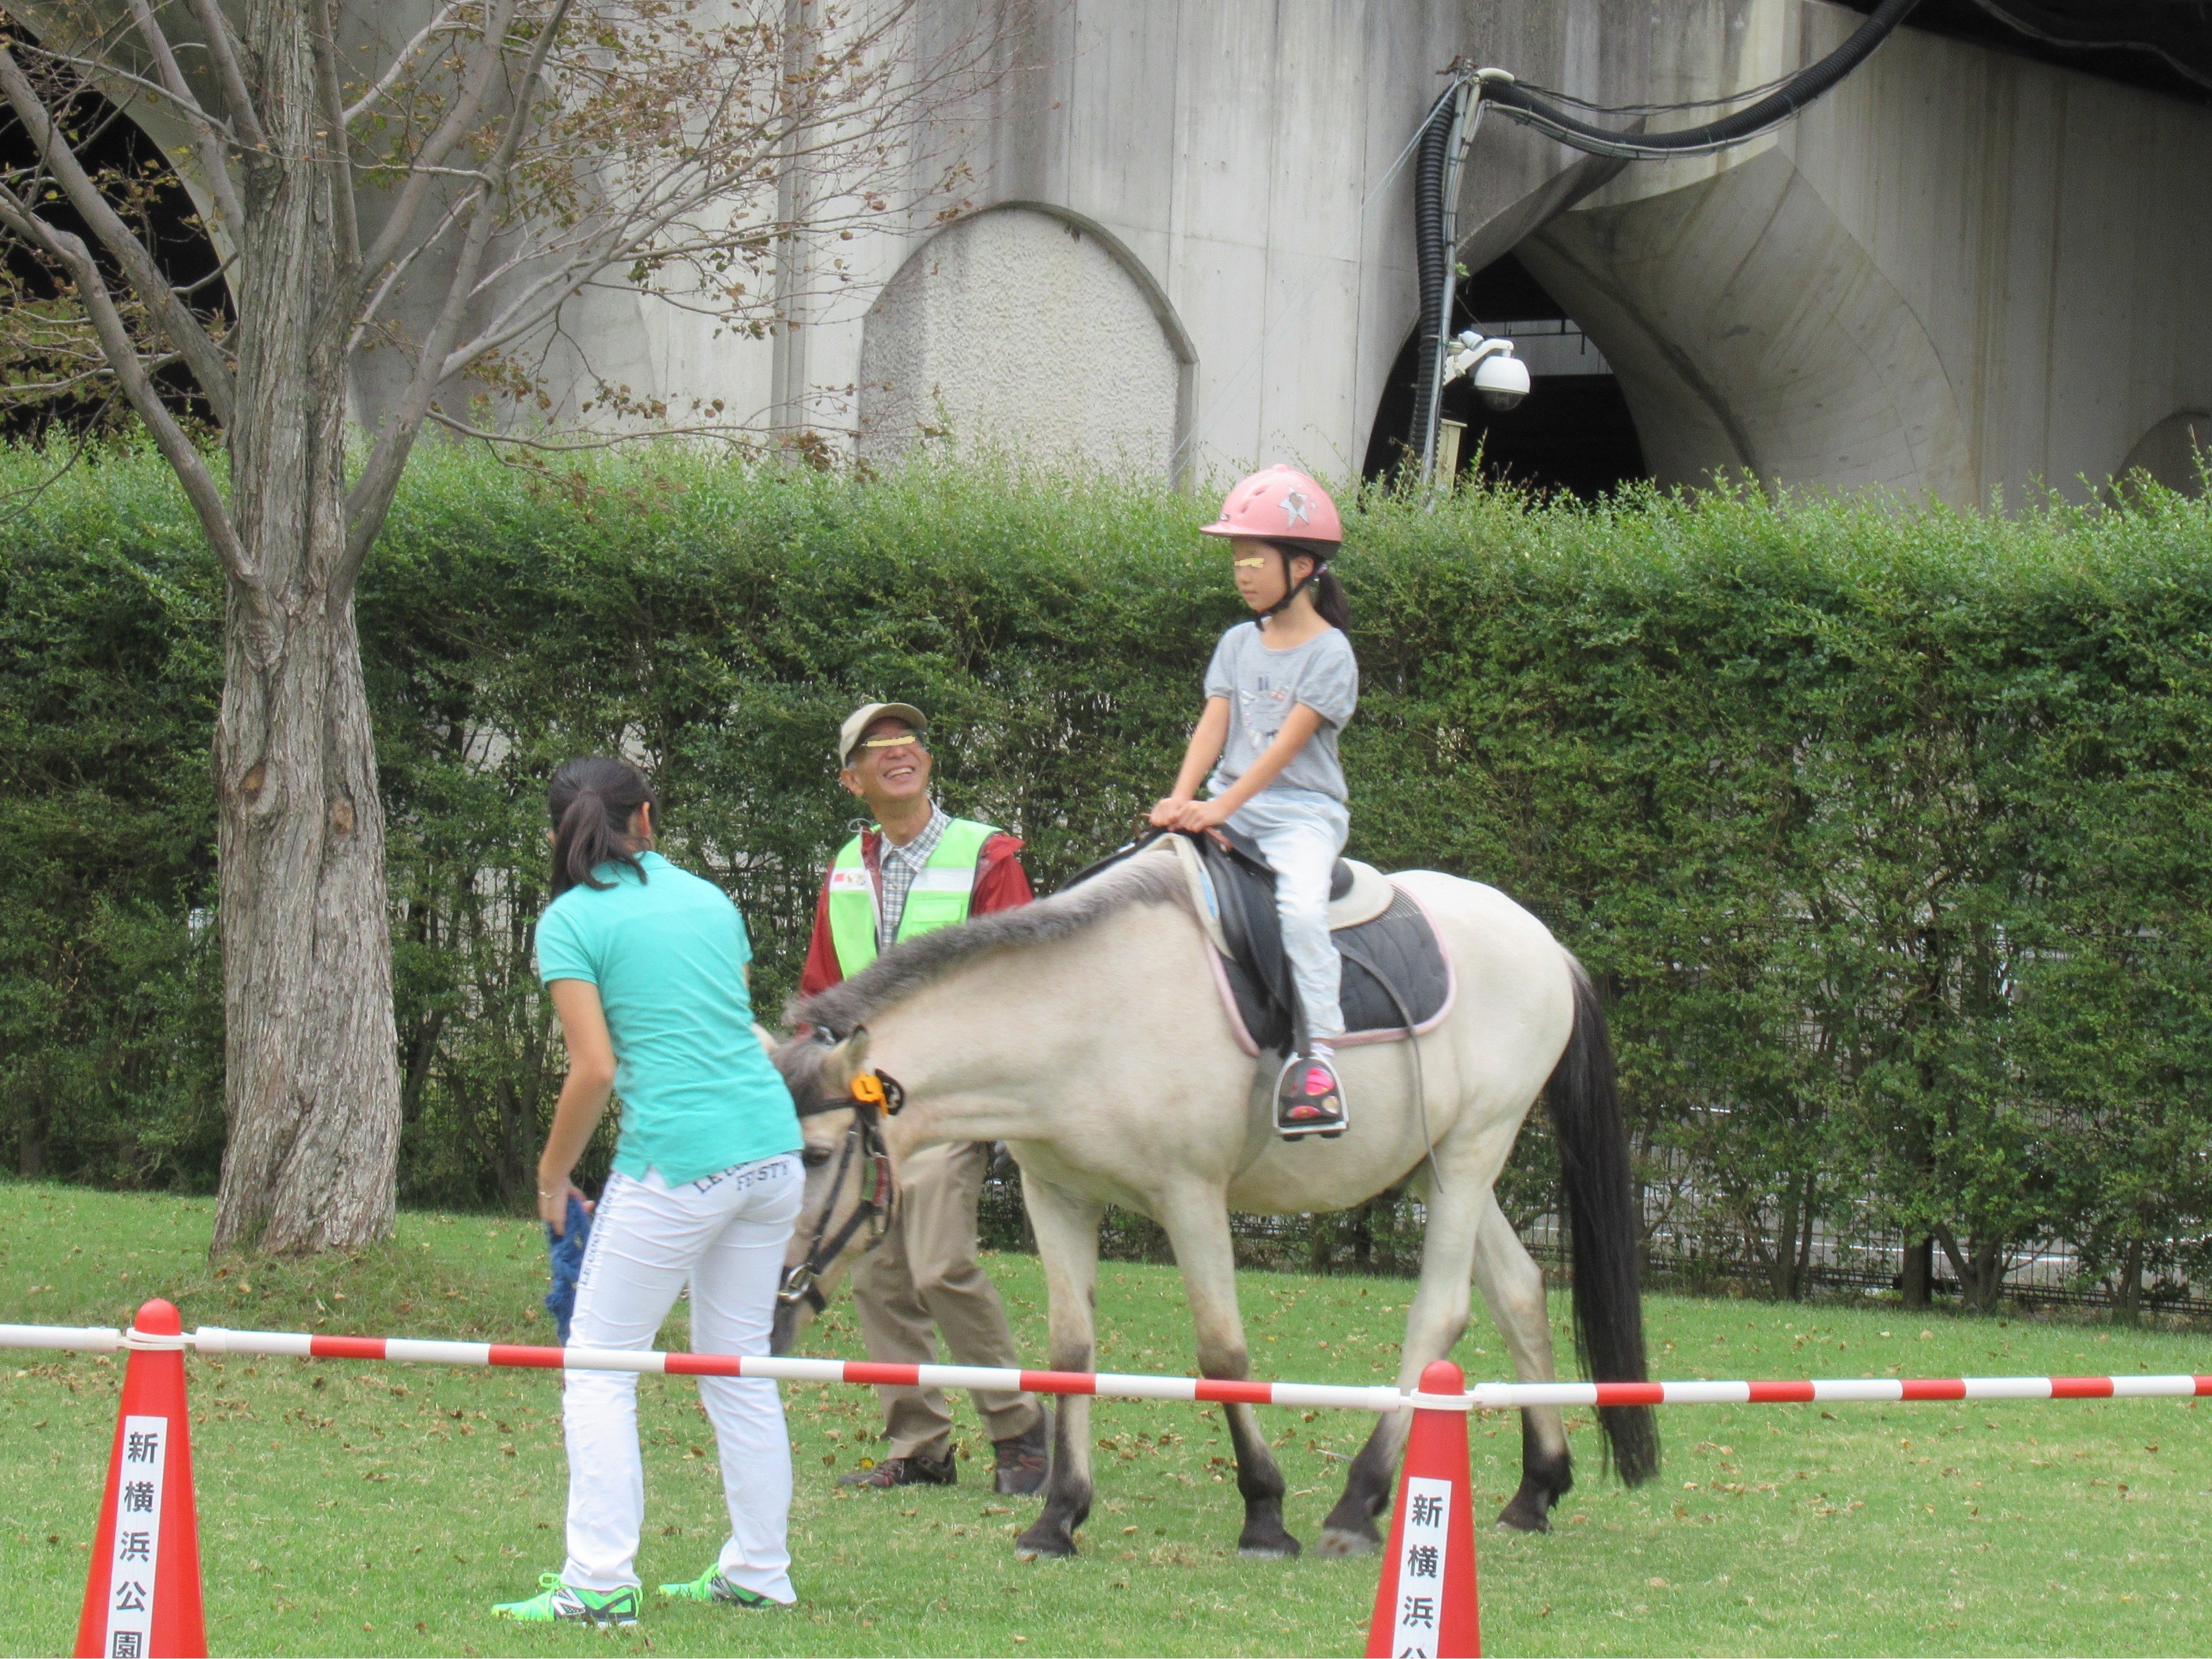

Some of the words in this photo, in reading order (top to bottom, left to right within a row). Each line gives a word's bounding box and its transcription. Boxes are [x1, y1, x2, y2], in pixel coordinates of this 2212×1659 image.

[112, 1431, 159, 1659] 新横浜公園
